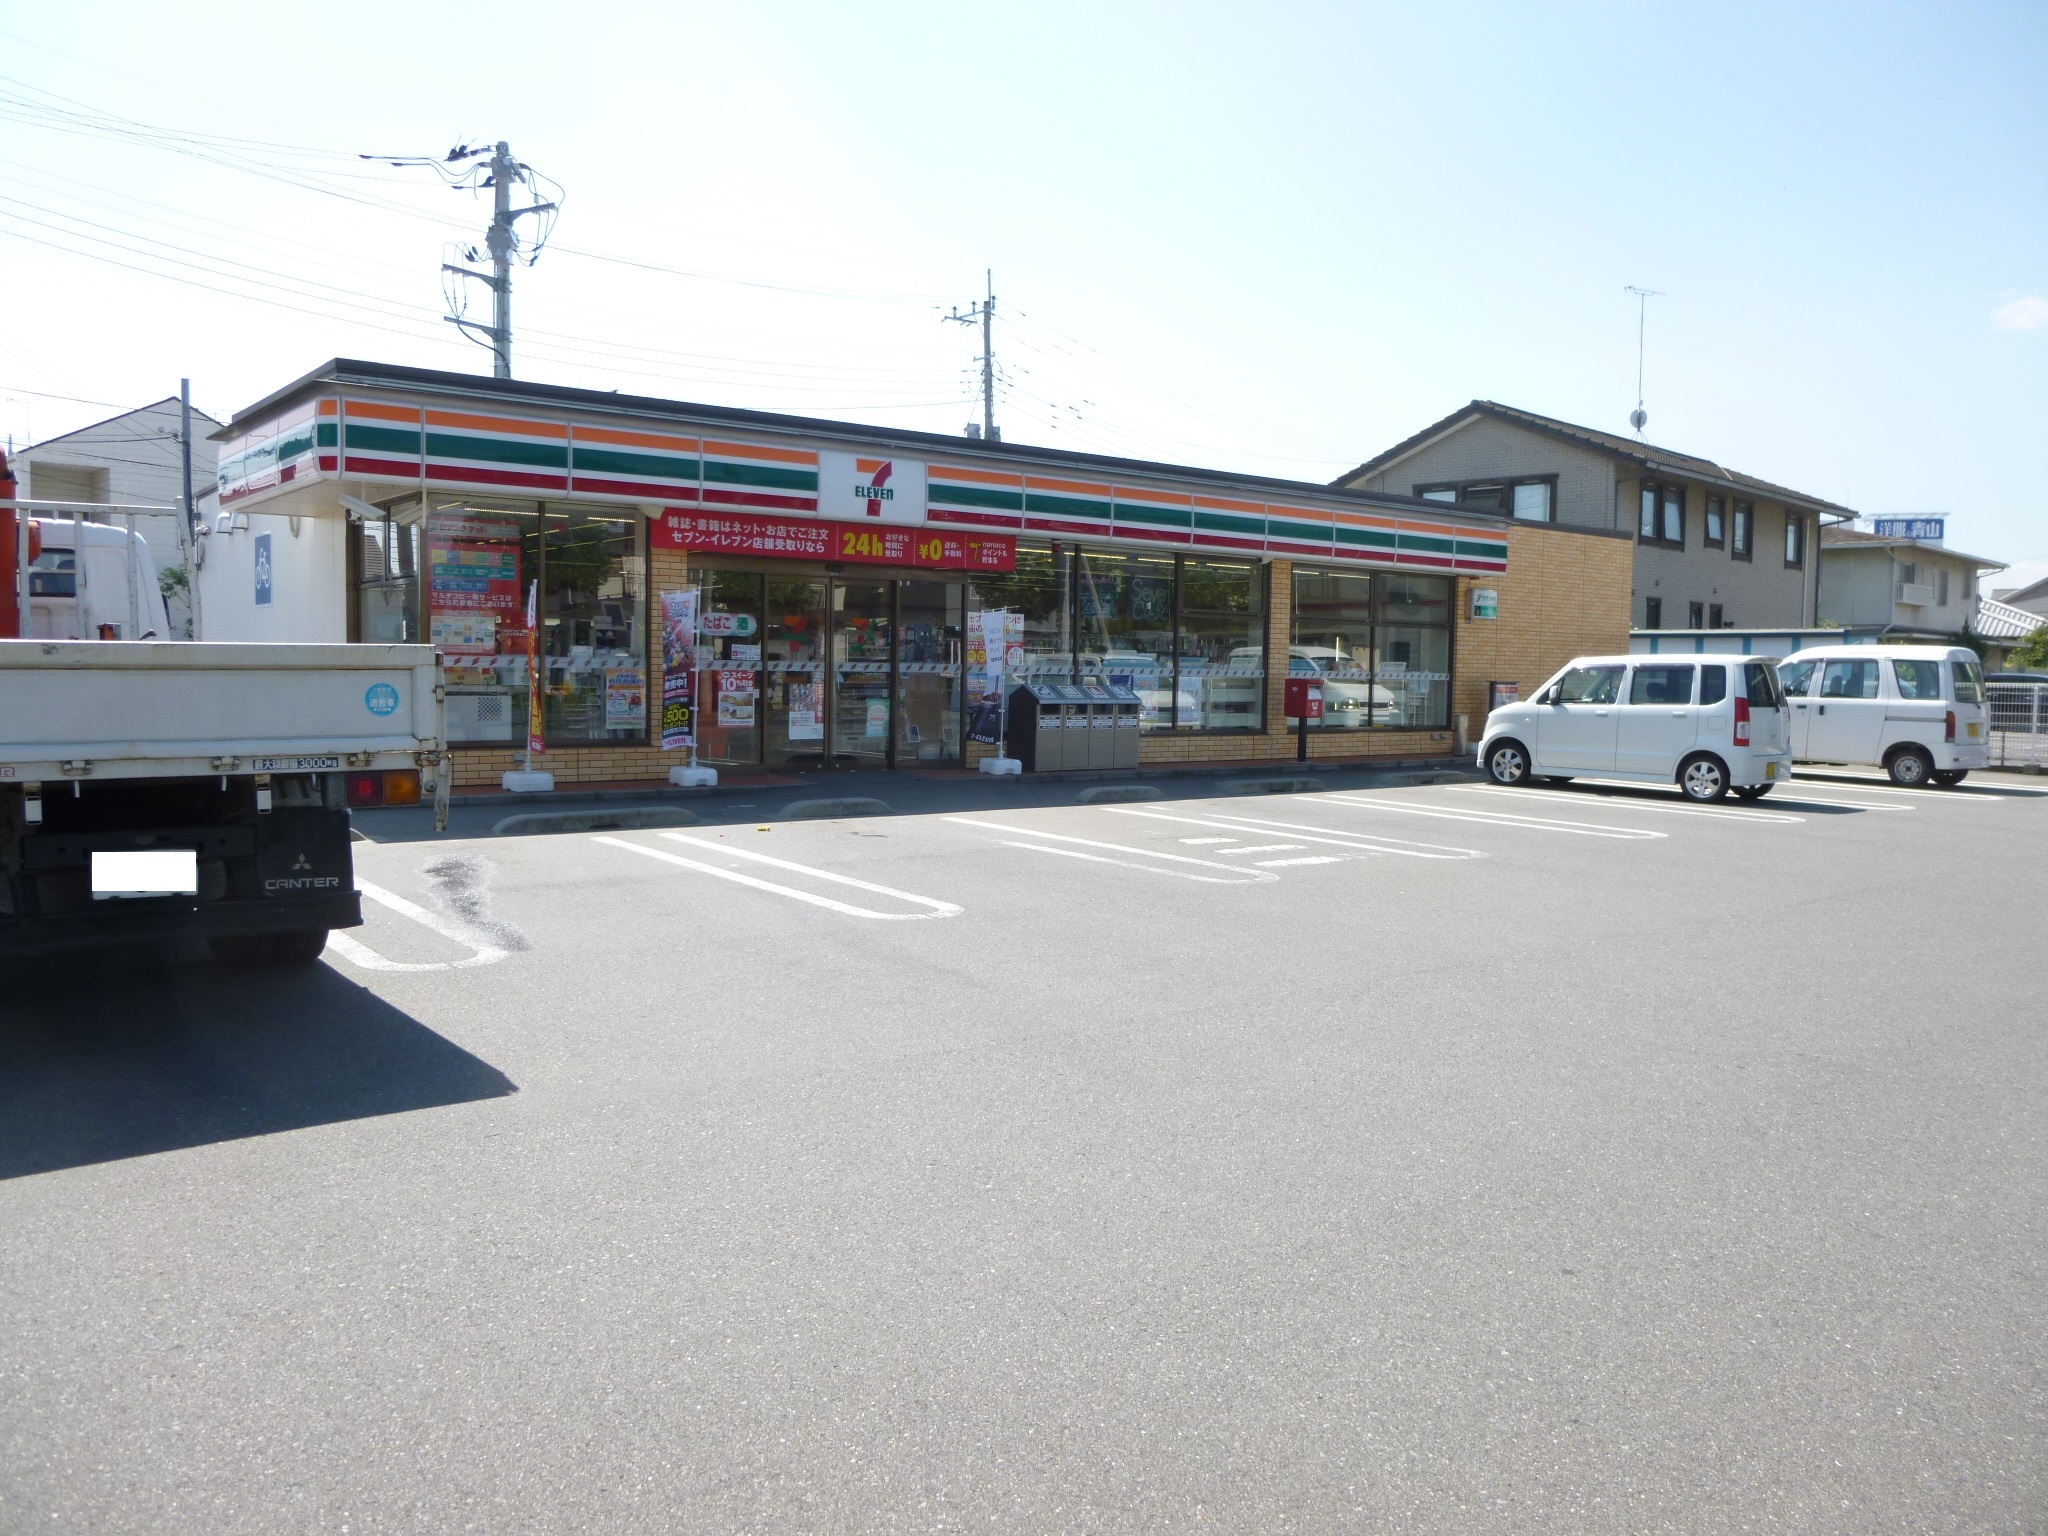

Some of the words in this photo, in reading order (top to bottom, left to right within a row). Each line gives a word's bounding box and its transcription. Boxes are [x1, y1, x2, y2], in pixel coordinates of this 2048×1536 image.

[1880, 521, 1940, 537] 洋服の青山
[843, 532, 884, 557] 24h
[982, 541, 1006, 549] nanaco
[703, 616, 731, 629] たばこ
[265, 876, 340, 890] CANTER
